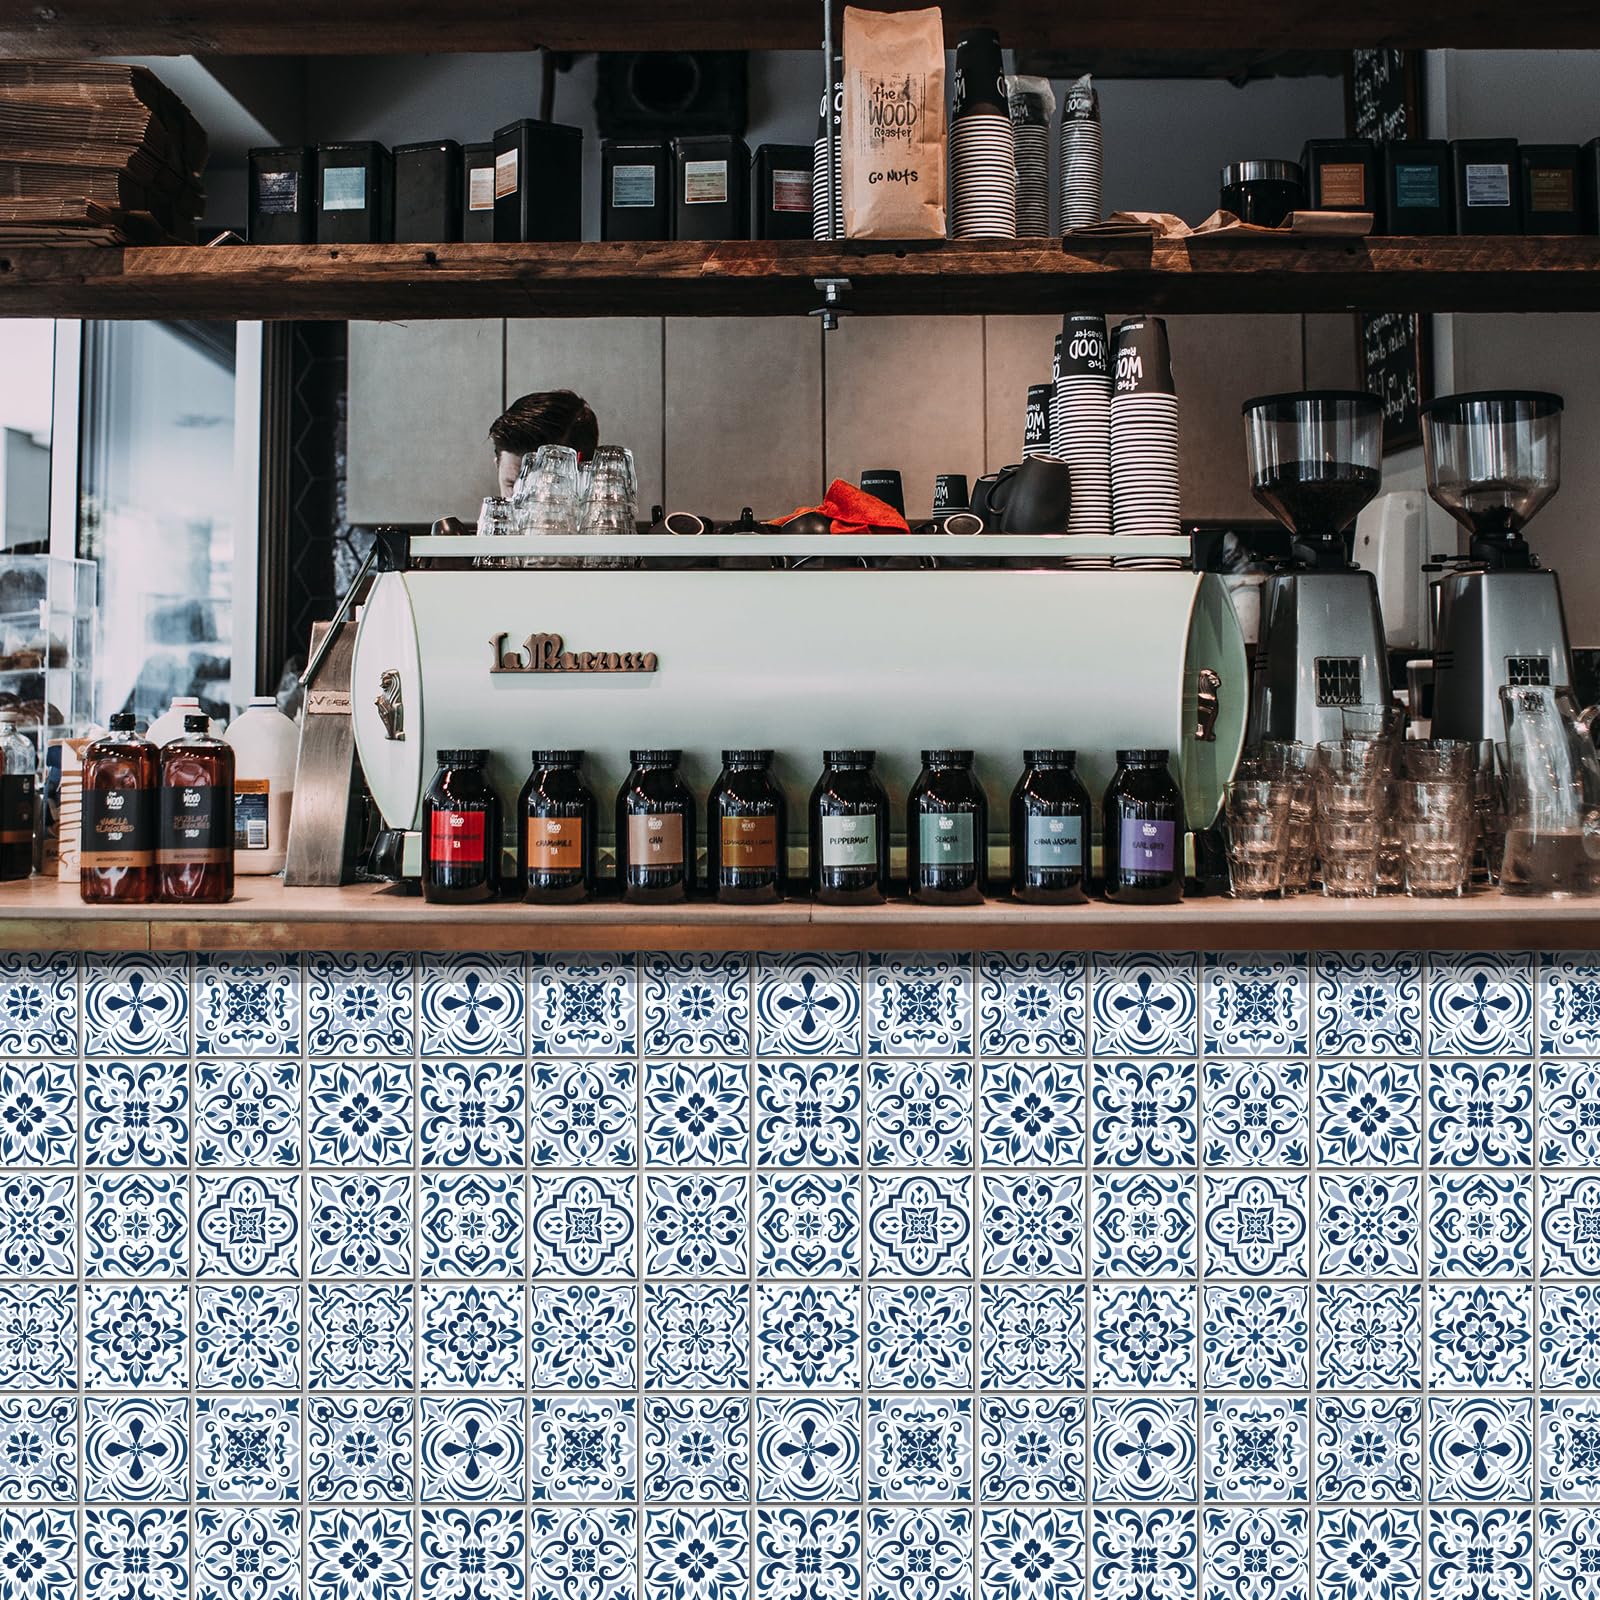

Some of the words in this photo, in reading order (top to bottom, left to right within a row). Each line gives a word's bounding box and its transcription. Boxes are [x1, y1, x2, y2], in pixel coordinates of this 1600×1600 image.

[873, 86, 896, 102] the
[868, 100, 918, 127] WOOD
[874, 126, 912, 140] Roaster
[1088, 359, 1107, 371] the
[1117, 376, 1138, 391] the
[488, 632, 524, 672] La
[523, 632, 658, 672] Marzocco
[1319, 695, 1361, 705] MAZZER
[106, 795, 125, 806] WOOD
[183, 792, 201, 803] WOOD
[830, 836, 869, 845] PEPPERMINT
